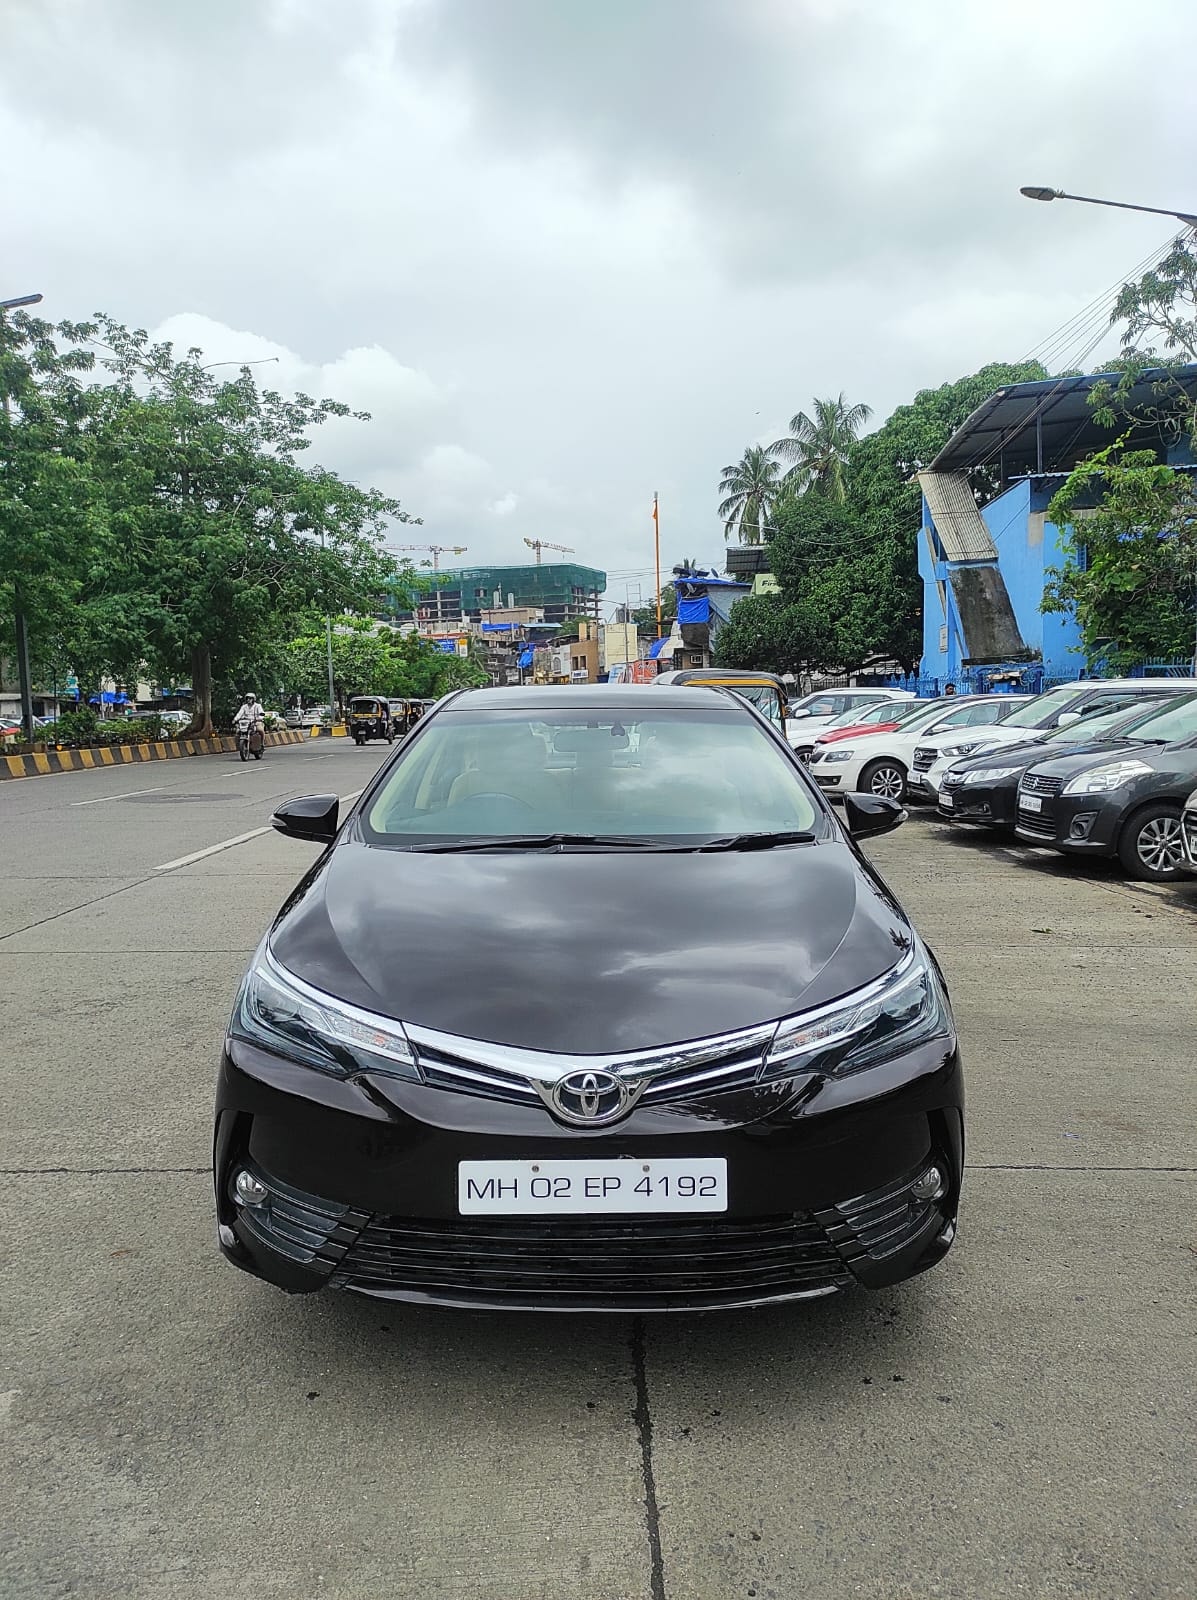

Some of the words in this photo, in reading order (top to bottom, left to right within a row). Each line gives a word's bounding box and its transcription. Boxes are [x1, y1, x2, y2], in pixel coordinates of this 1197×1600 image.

[467, 1178, 518, 1200] MH
[530, 1177, 572, 1199] 02
[584, 1177, 622, 1198] EP
[633, 1176, 718, 1198] 4192
